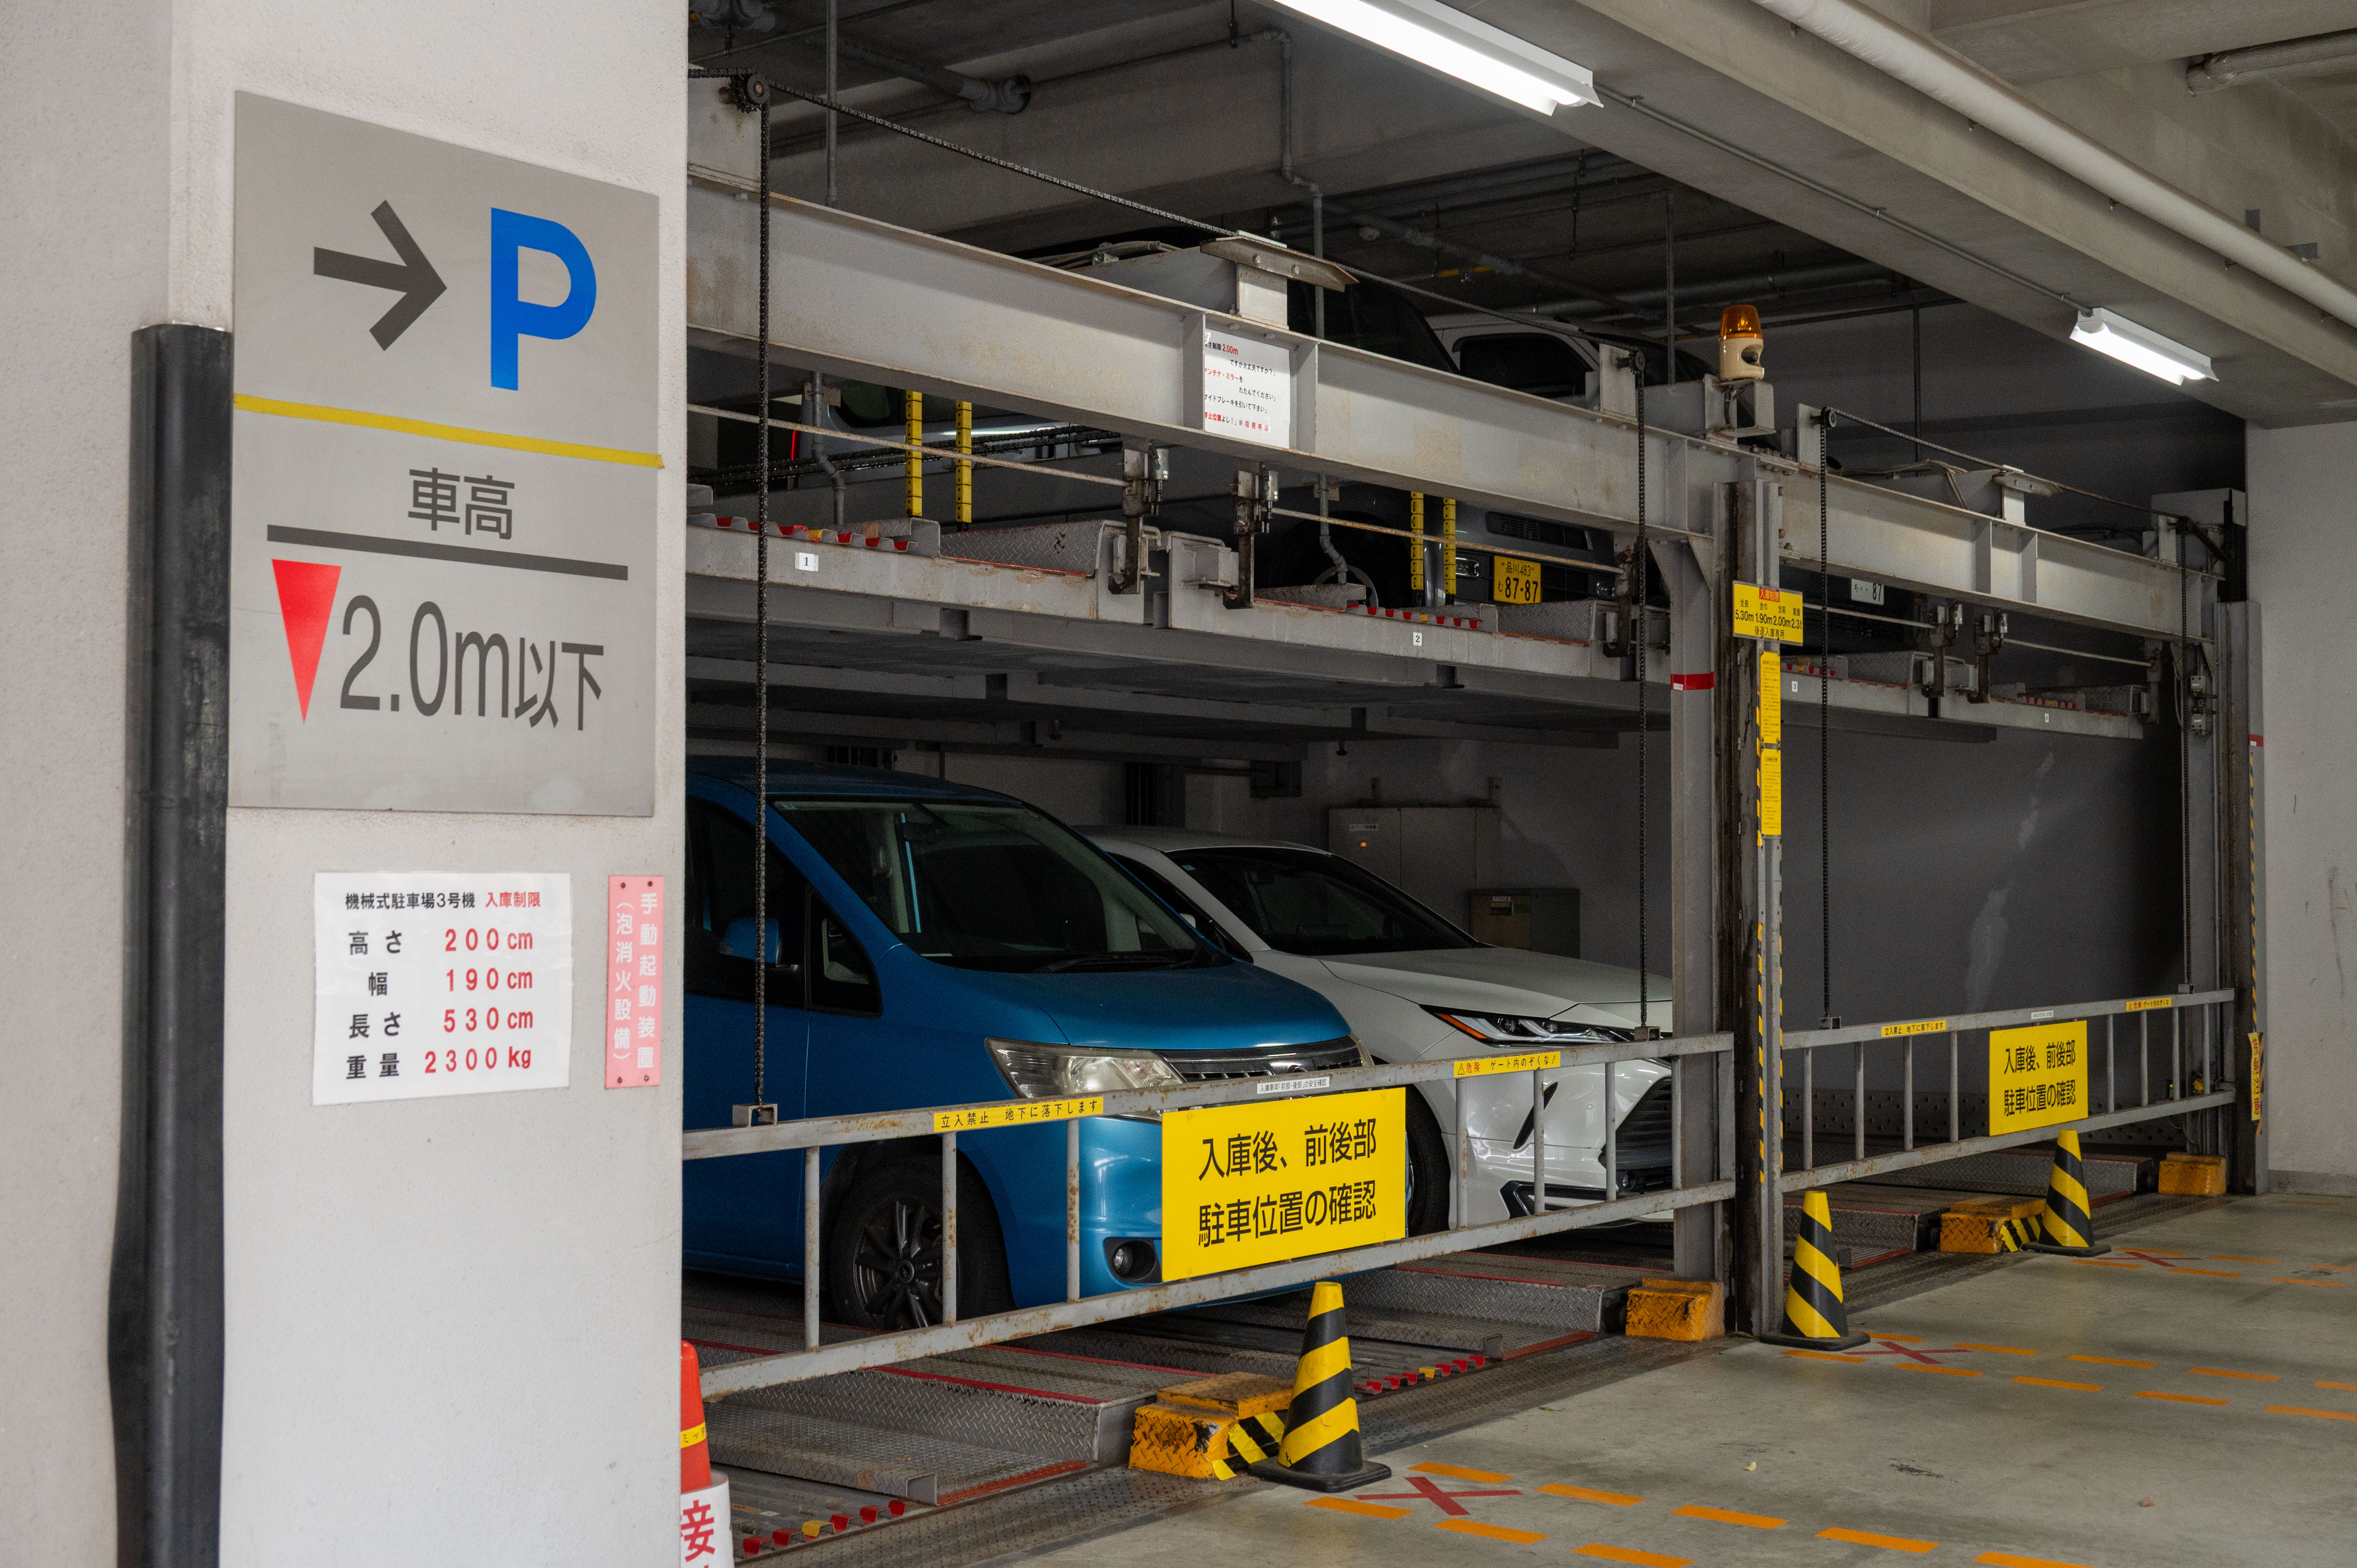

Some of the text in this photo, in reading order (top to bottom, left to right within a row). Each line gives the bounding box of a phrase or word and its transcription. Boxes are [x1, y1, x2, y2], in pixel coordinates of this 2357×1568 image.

[491, 207, 596, 391] P
[1223, 344, 1238, 355] 2.00m
[408, 468, 514, 540] 車高
[804, 557, 809, 566] 1
[1740, 599, 1749, 607] 全長
[1735, 609, 1802, 630] 5.30m 1.90m 2.00m 2.3t
[340, 595, 604, 731] 2.0m以下
[345, 892, 541, 910] 機械式駐車場3号機 入庫制限
[348, 930, 402, 955] 高さ
[368, 972, 388, 996] 幅
[637, 893, 657, 1068] 手動起動装置
[349, 1012, 401, 1039] 長さ
[346, 1052, 400, 1080] 重量
[1466, 1061, 1480, 1074] 危険
[2004, 1079, 2076, 1117] 駐車位置の確認
[941, 1100, 1097, 1128] 立入禁止 地下に落下します
[1198, 1180, 1377, 1247] 駐車位置の確認
